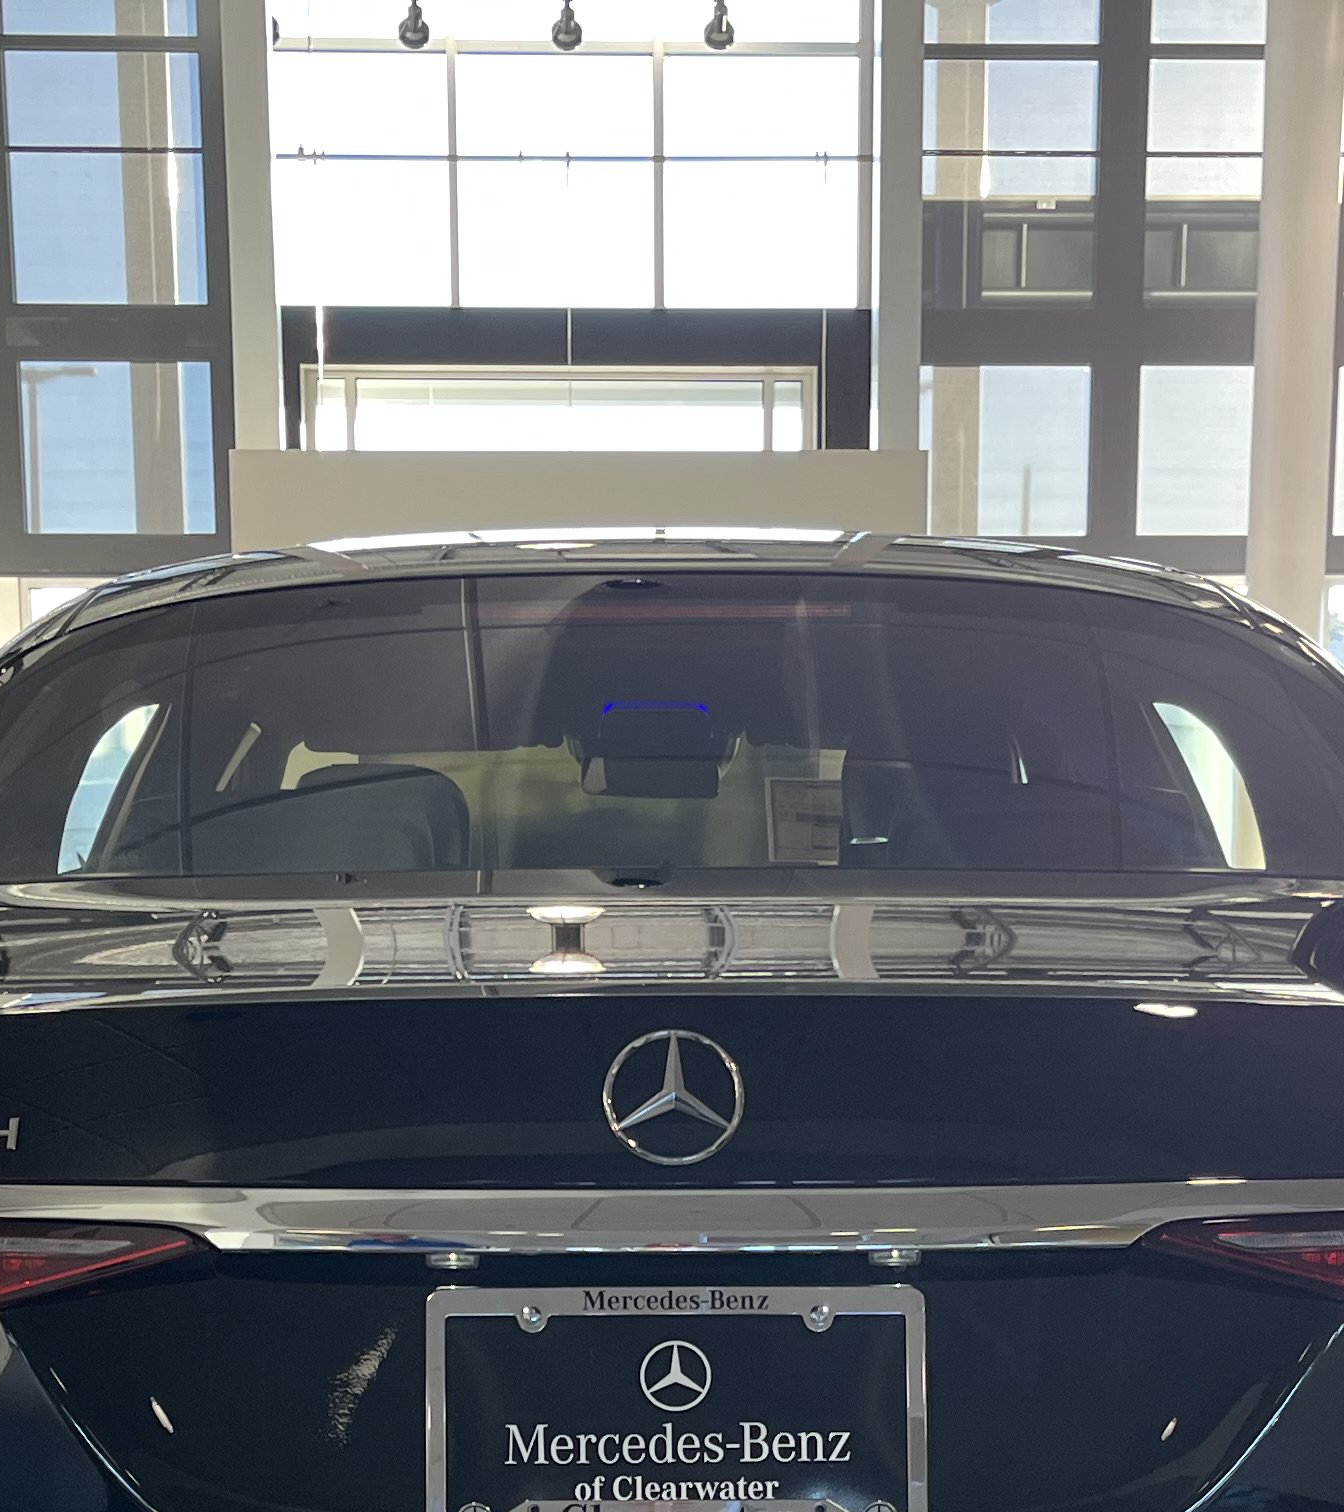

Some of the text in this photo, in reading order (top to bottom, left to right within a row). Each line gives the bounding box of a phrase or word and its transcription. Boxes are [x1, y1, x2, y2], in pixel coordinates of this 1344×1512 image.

[582, 1289, 769, 1312] Mercedes-Benz
[504, 1421, 851, 1465] Mercedes-Benz
[574, 1473, 780, 1501] of Clearwater
